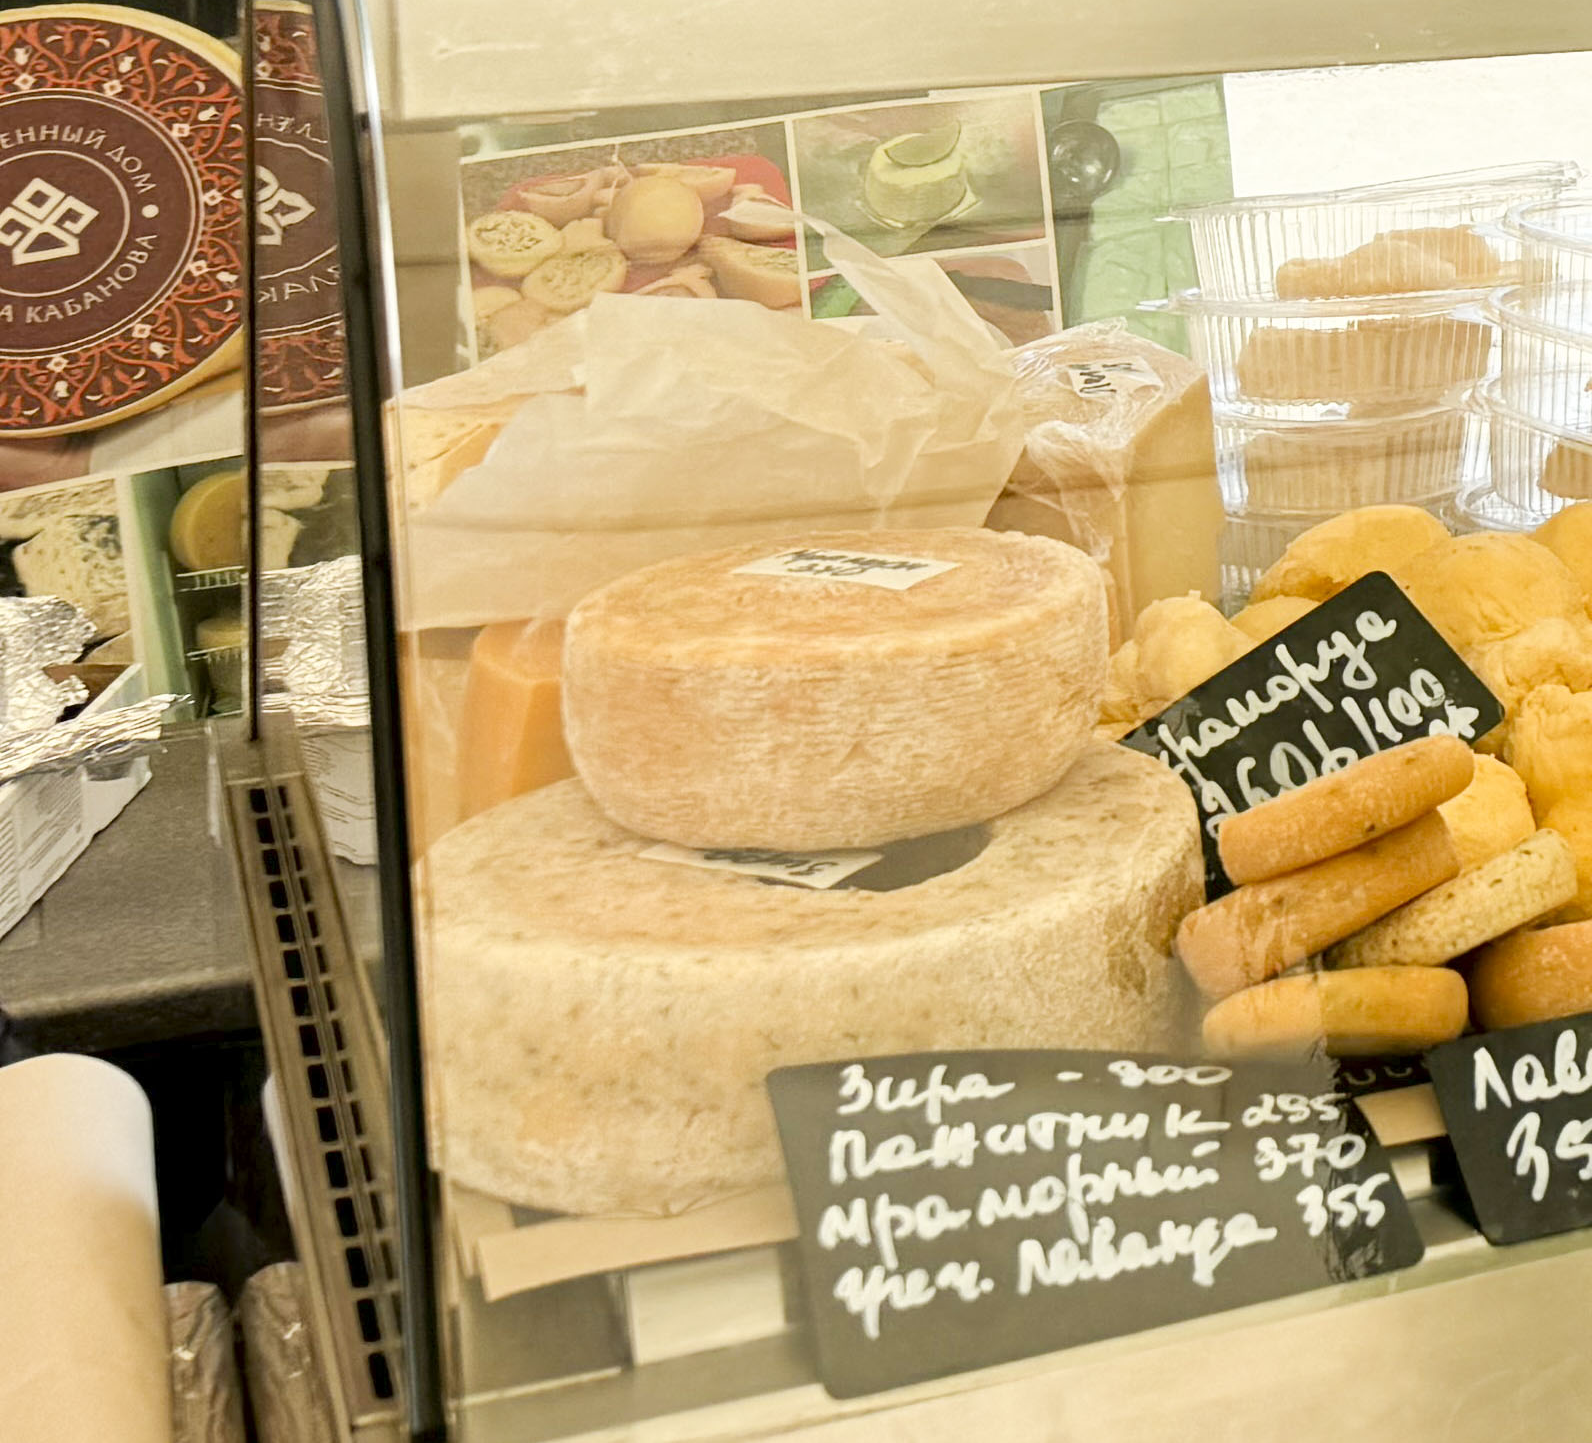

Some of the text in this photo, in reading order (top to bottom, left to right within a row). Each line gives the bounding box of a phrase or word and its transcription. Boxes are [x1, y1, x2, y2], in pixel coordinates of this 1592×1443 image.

[105, 146, 157, 194] ДОМ
[25, 234, 158, 323] КАБАНОВА
[837, 1064, 1015, 1124] Зира
[1254, 1132, 1367, 1182] 370
[1297, 1173, 1390, 1237] 355
